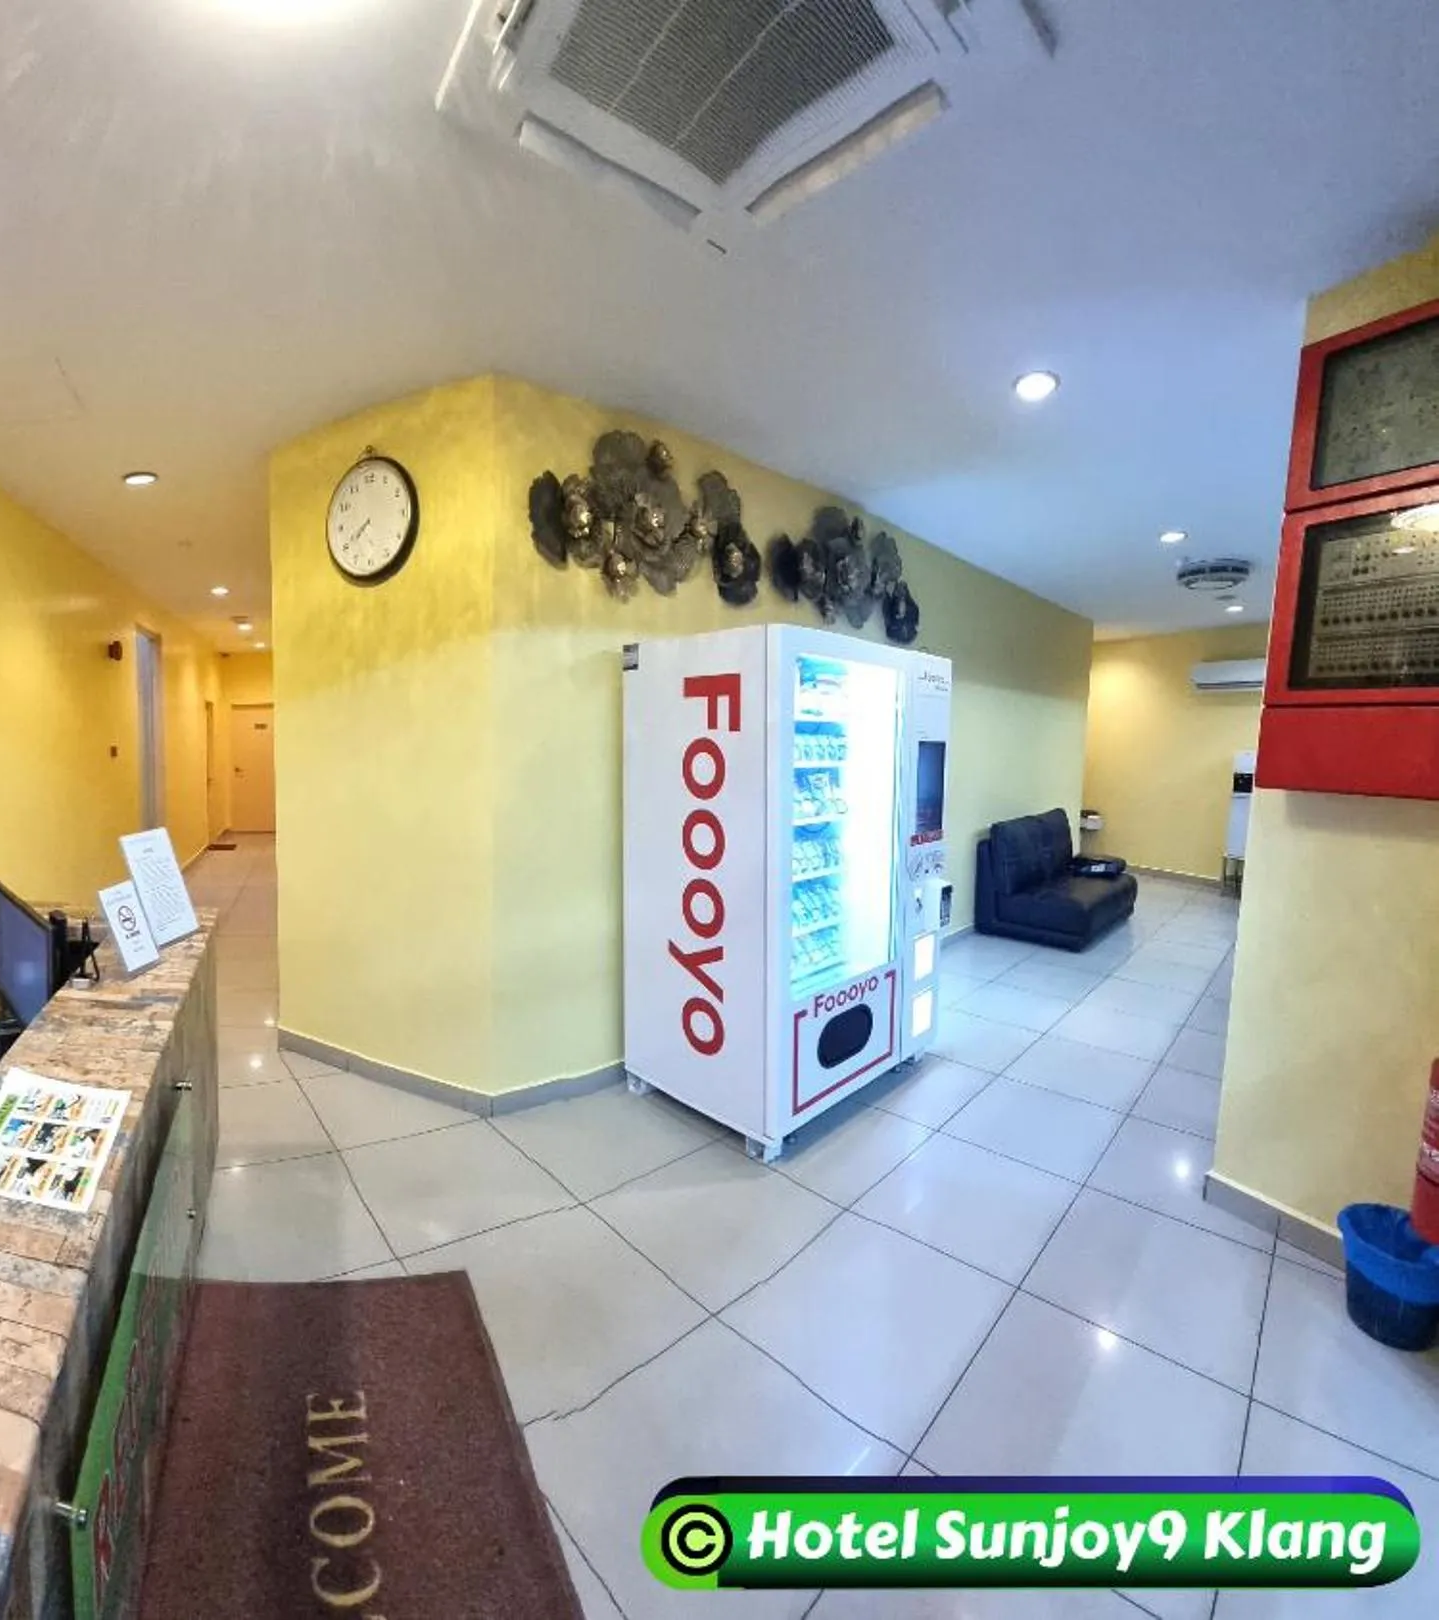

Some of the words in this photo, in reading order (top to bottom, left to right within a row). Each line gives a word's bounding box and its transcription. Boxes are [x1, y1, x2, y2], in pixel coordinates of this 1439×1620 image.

[668, 673, 741, 1056] Foooyo
[814, 976, 879, 1018] Foooyo
[306, 1390, 387, 1620] COME
